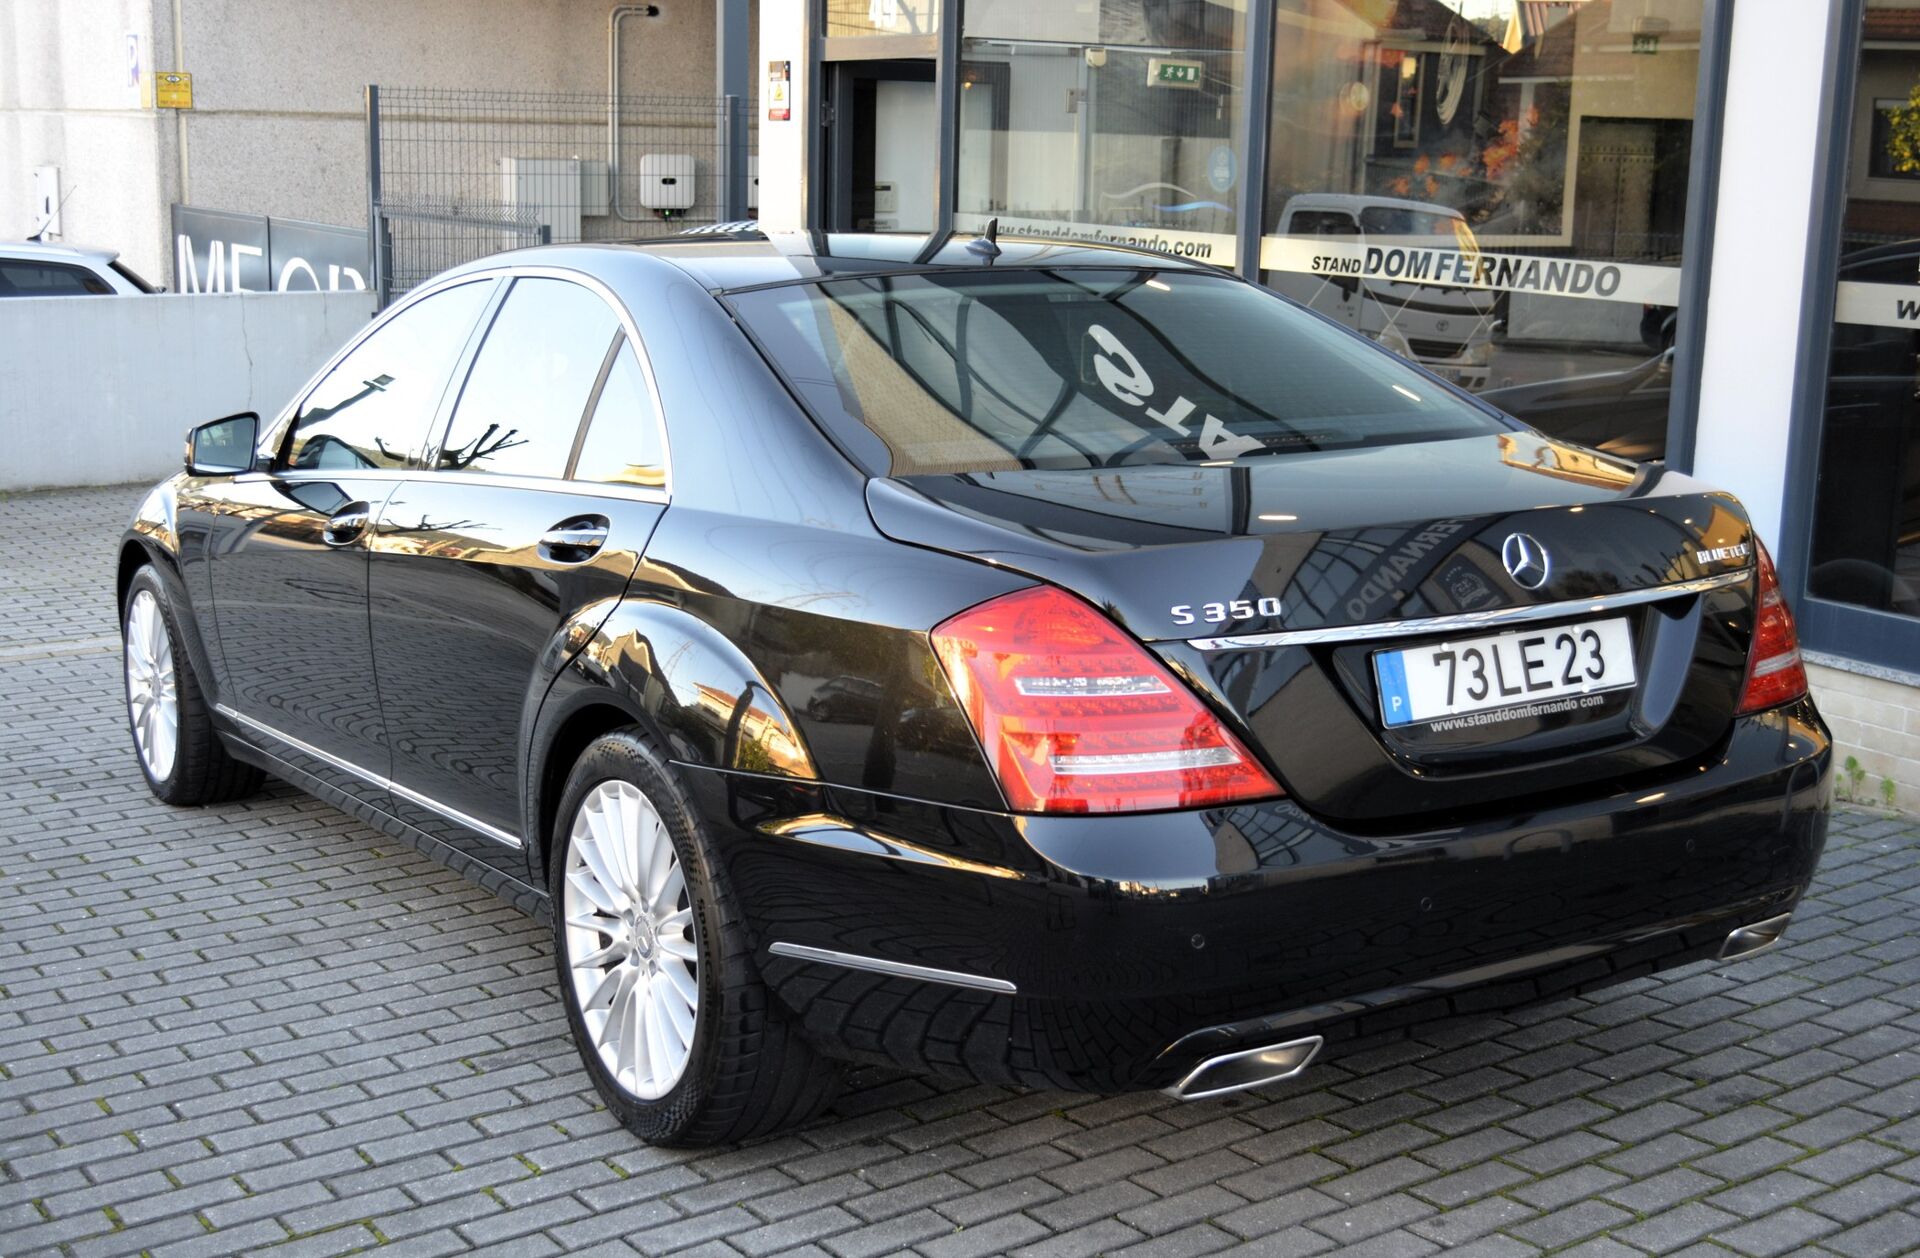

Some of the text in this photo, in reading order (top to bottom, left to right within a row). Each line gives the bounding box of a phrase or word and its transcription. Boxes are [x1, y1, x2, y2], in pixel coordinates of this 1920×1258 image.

[1311, 255, 1361, 274] STAND
[1170, 597, 1282, 625] S 350
[1391, 695, 1403, 712] P
